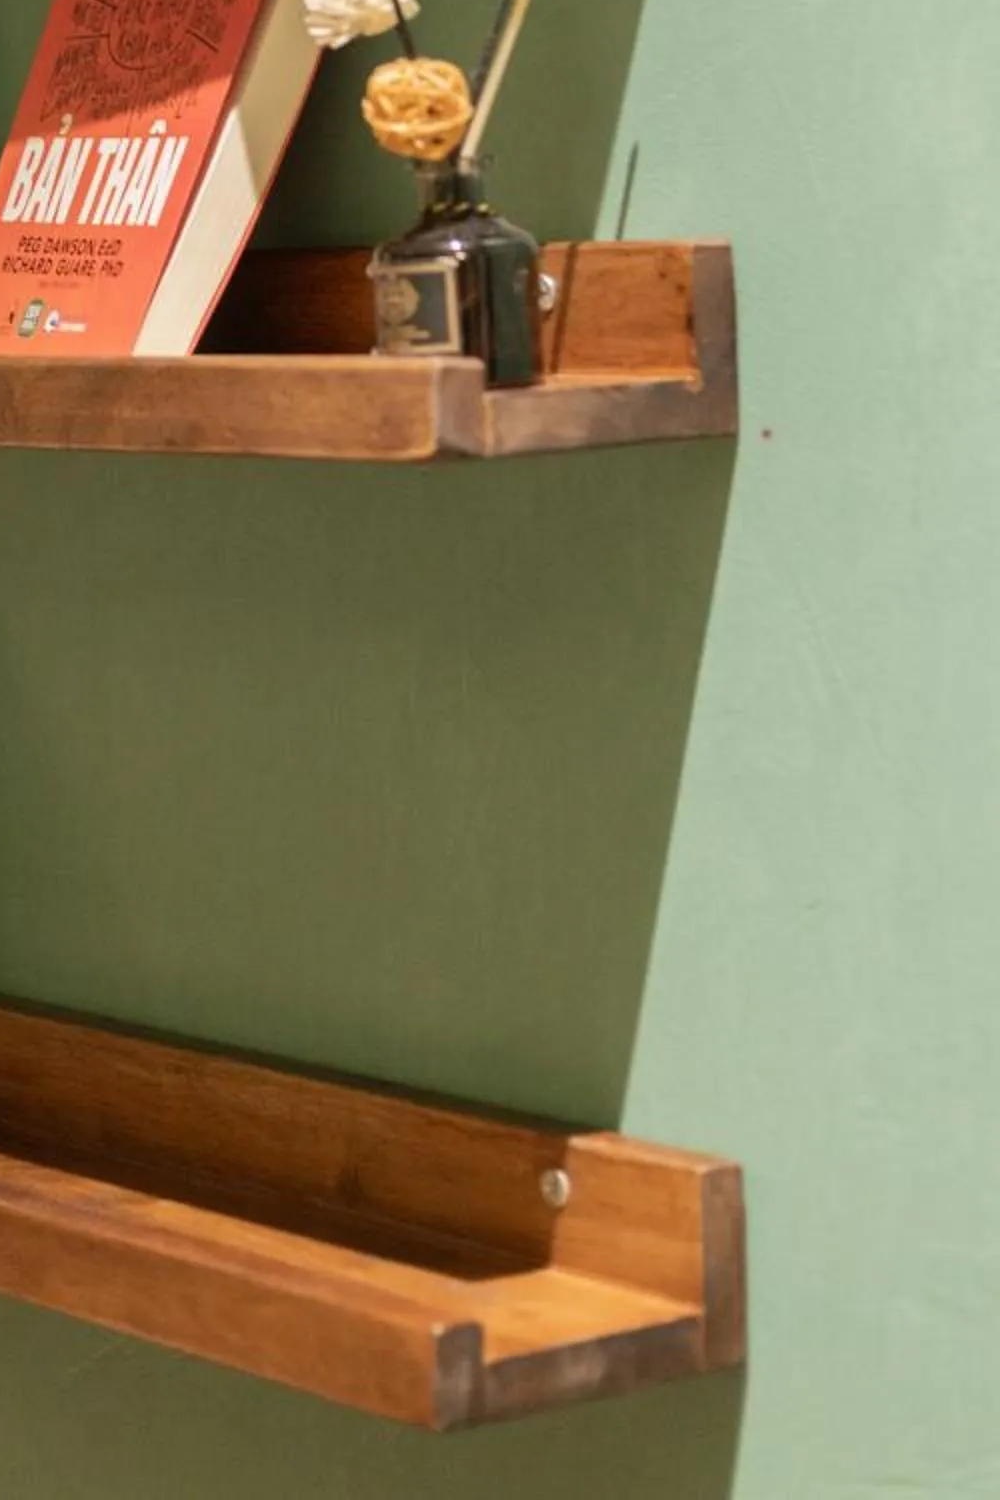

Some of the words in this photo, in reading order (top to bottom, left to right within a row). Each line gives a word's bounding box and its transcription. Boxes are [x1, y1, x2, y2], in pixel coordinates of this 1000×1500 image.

[0, 113, 95, 225] BẢN
[77, 119, 190, 228] THÂN
[17, 235, 43, 253] PEG
[2, 256, 54, 275] RICHARD
